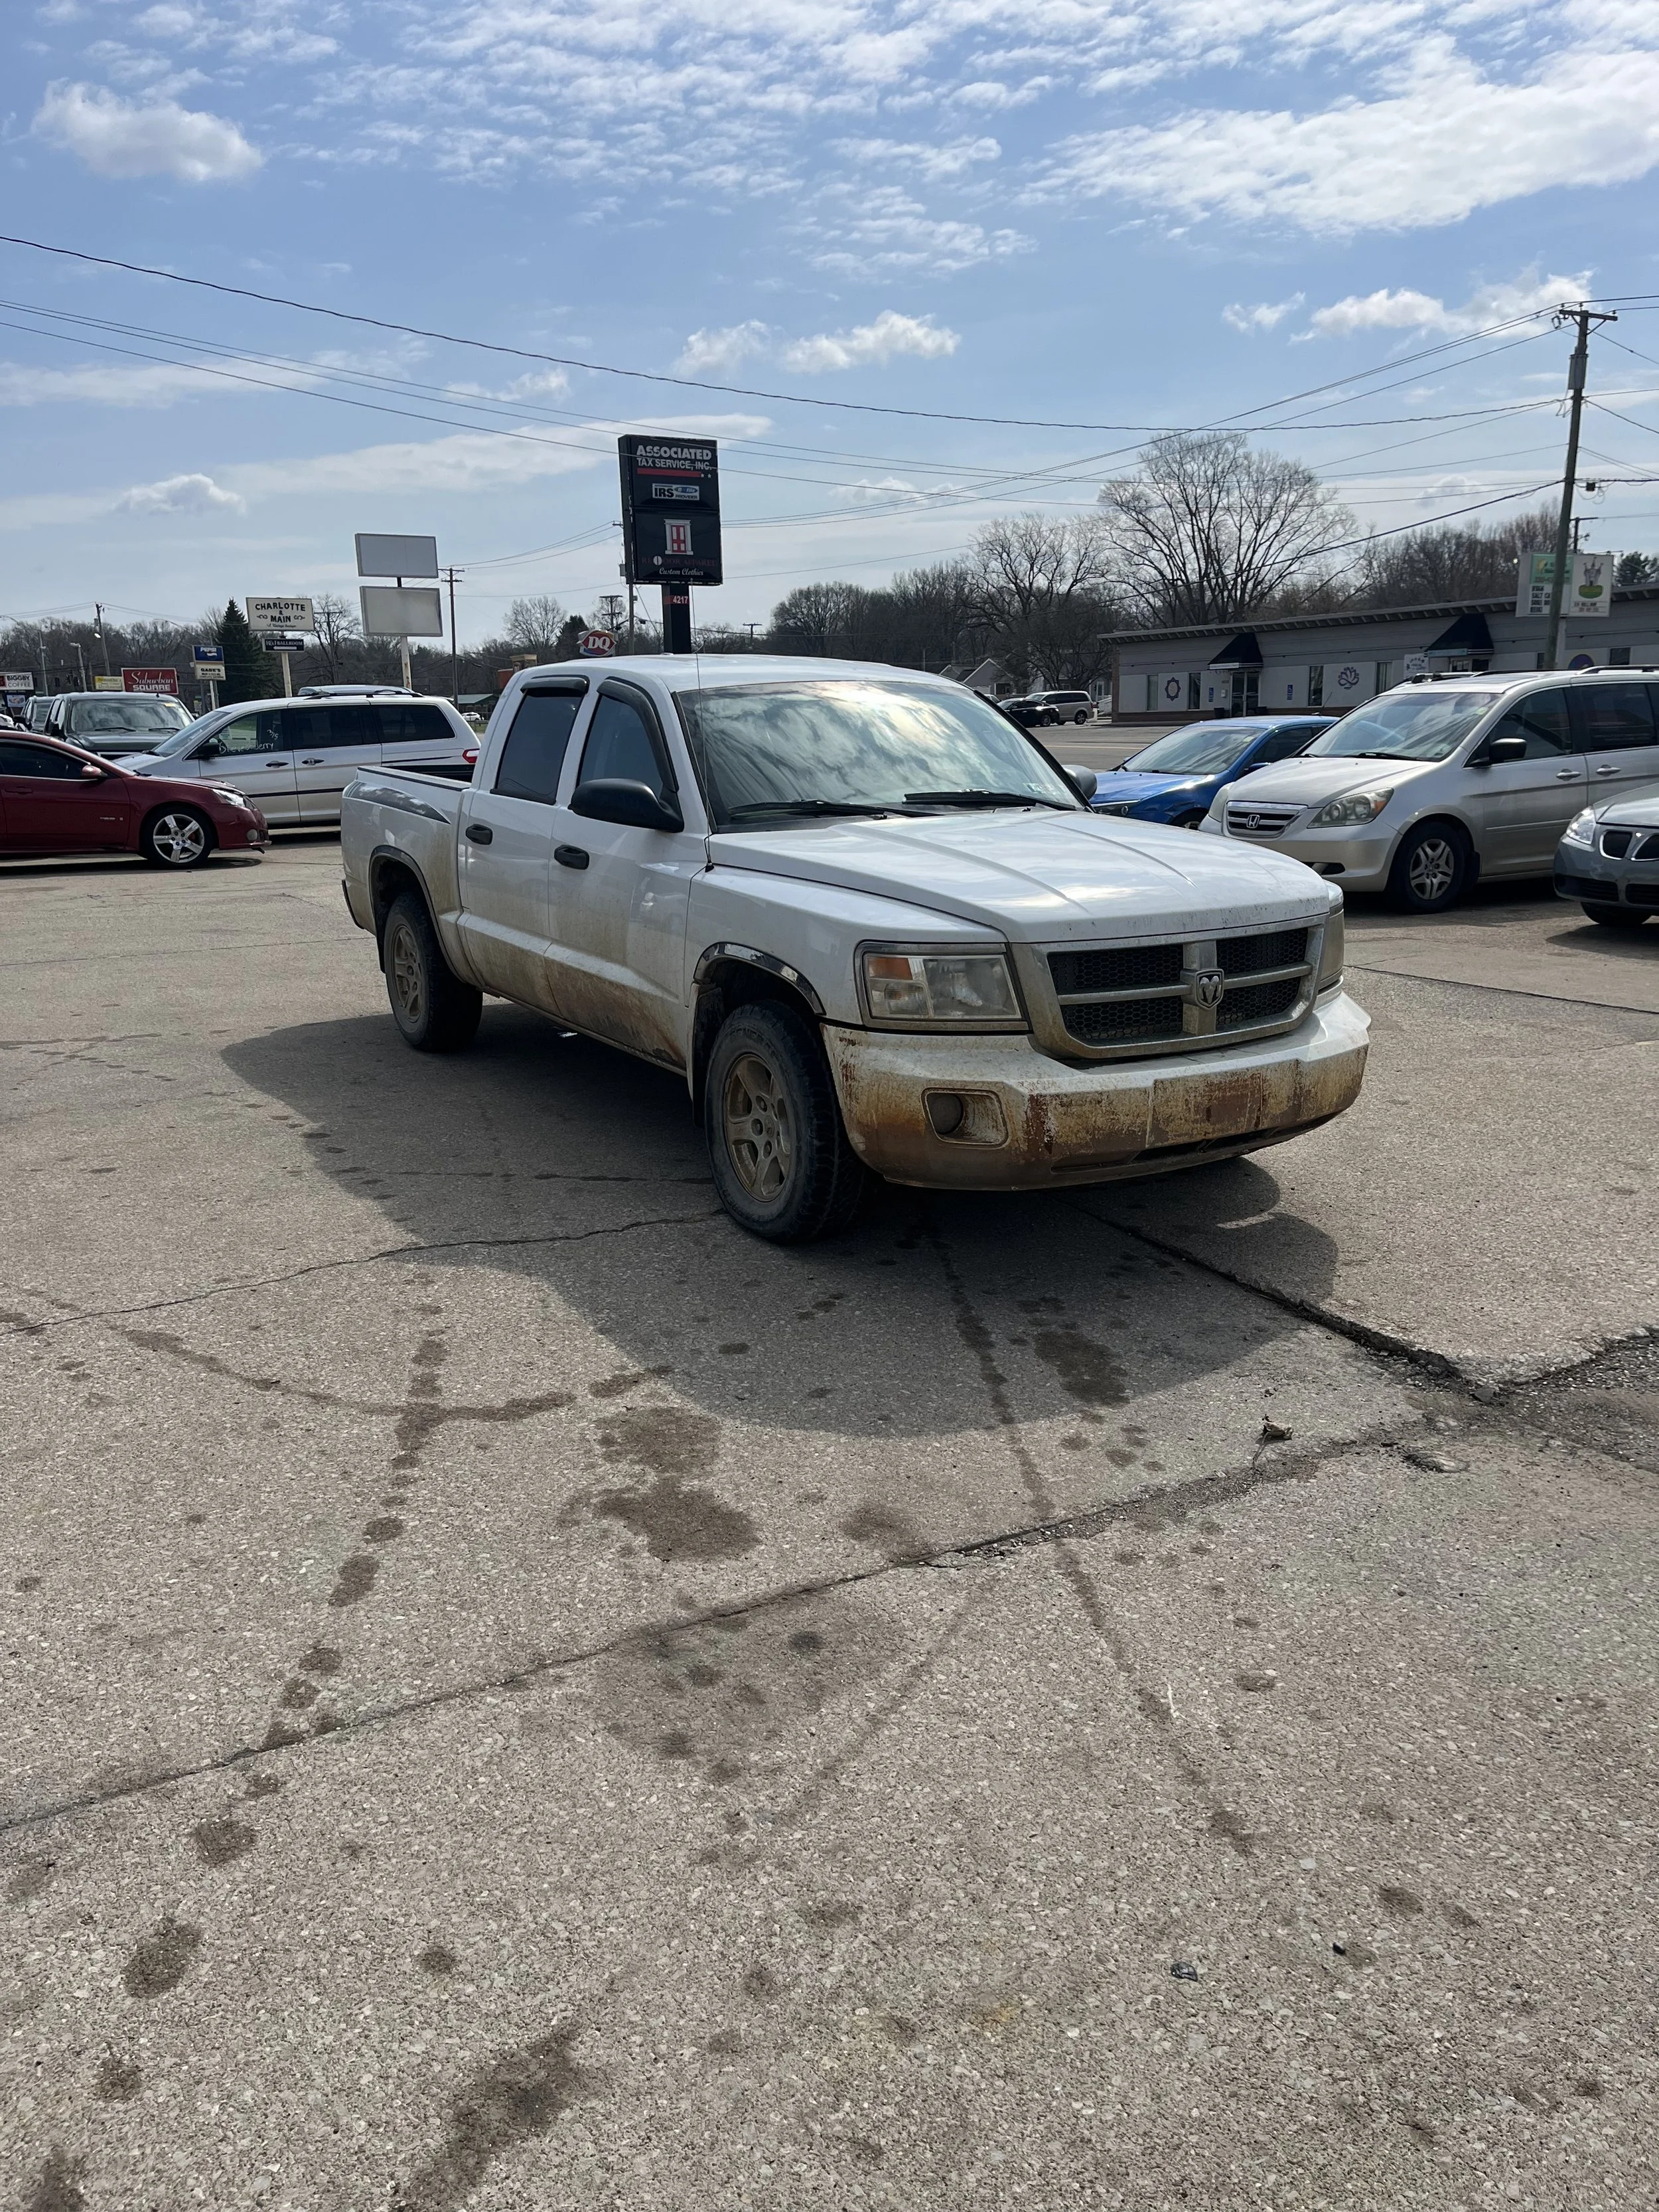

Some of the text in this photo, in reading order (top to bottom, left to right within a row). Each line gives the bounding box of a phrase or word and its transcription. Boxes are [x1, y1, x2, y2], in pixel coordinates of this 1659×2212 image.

[636, 445, 712, 460] ASSOCIATED
[636, 457, 654, 467] TAX
[654, 459, 693, 471] SERVICE,
[654, 487, 674, 498] IRS
[255, 602, 306, 611] CHARLOTTE
[587, 636, 611, 650] DQ
[128, 671, 173, 684] Suburban
